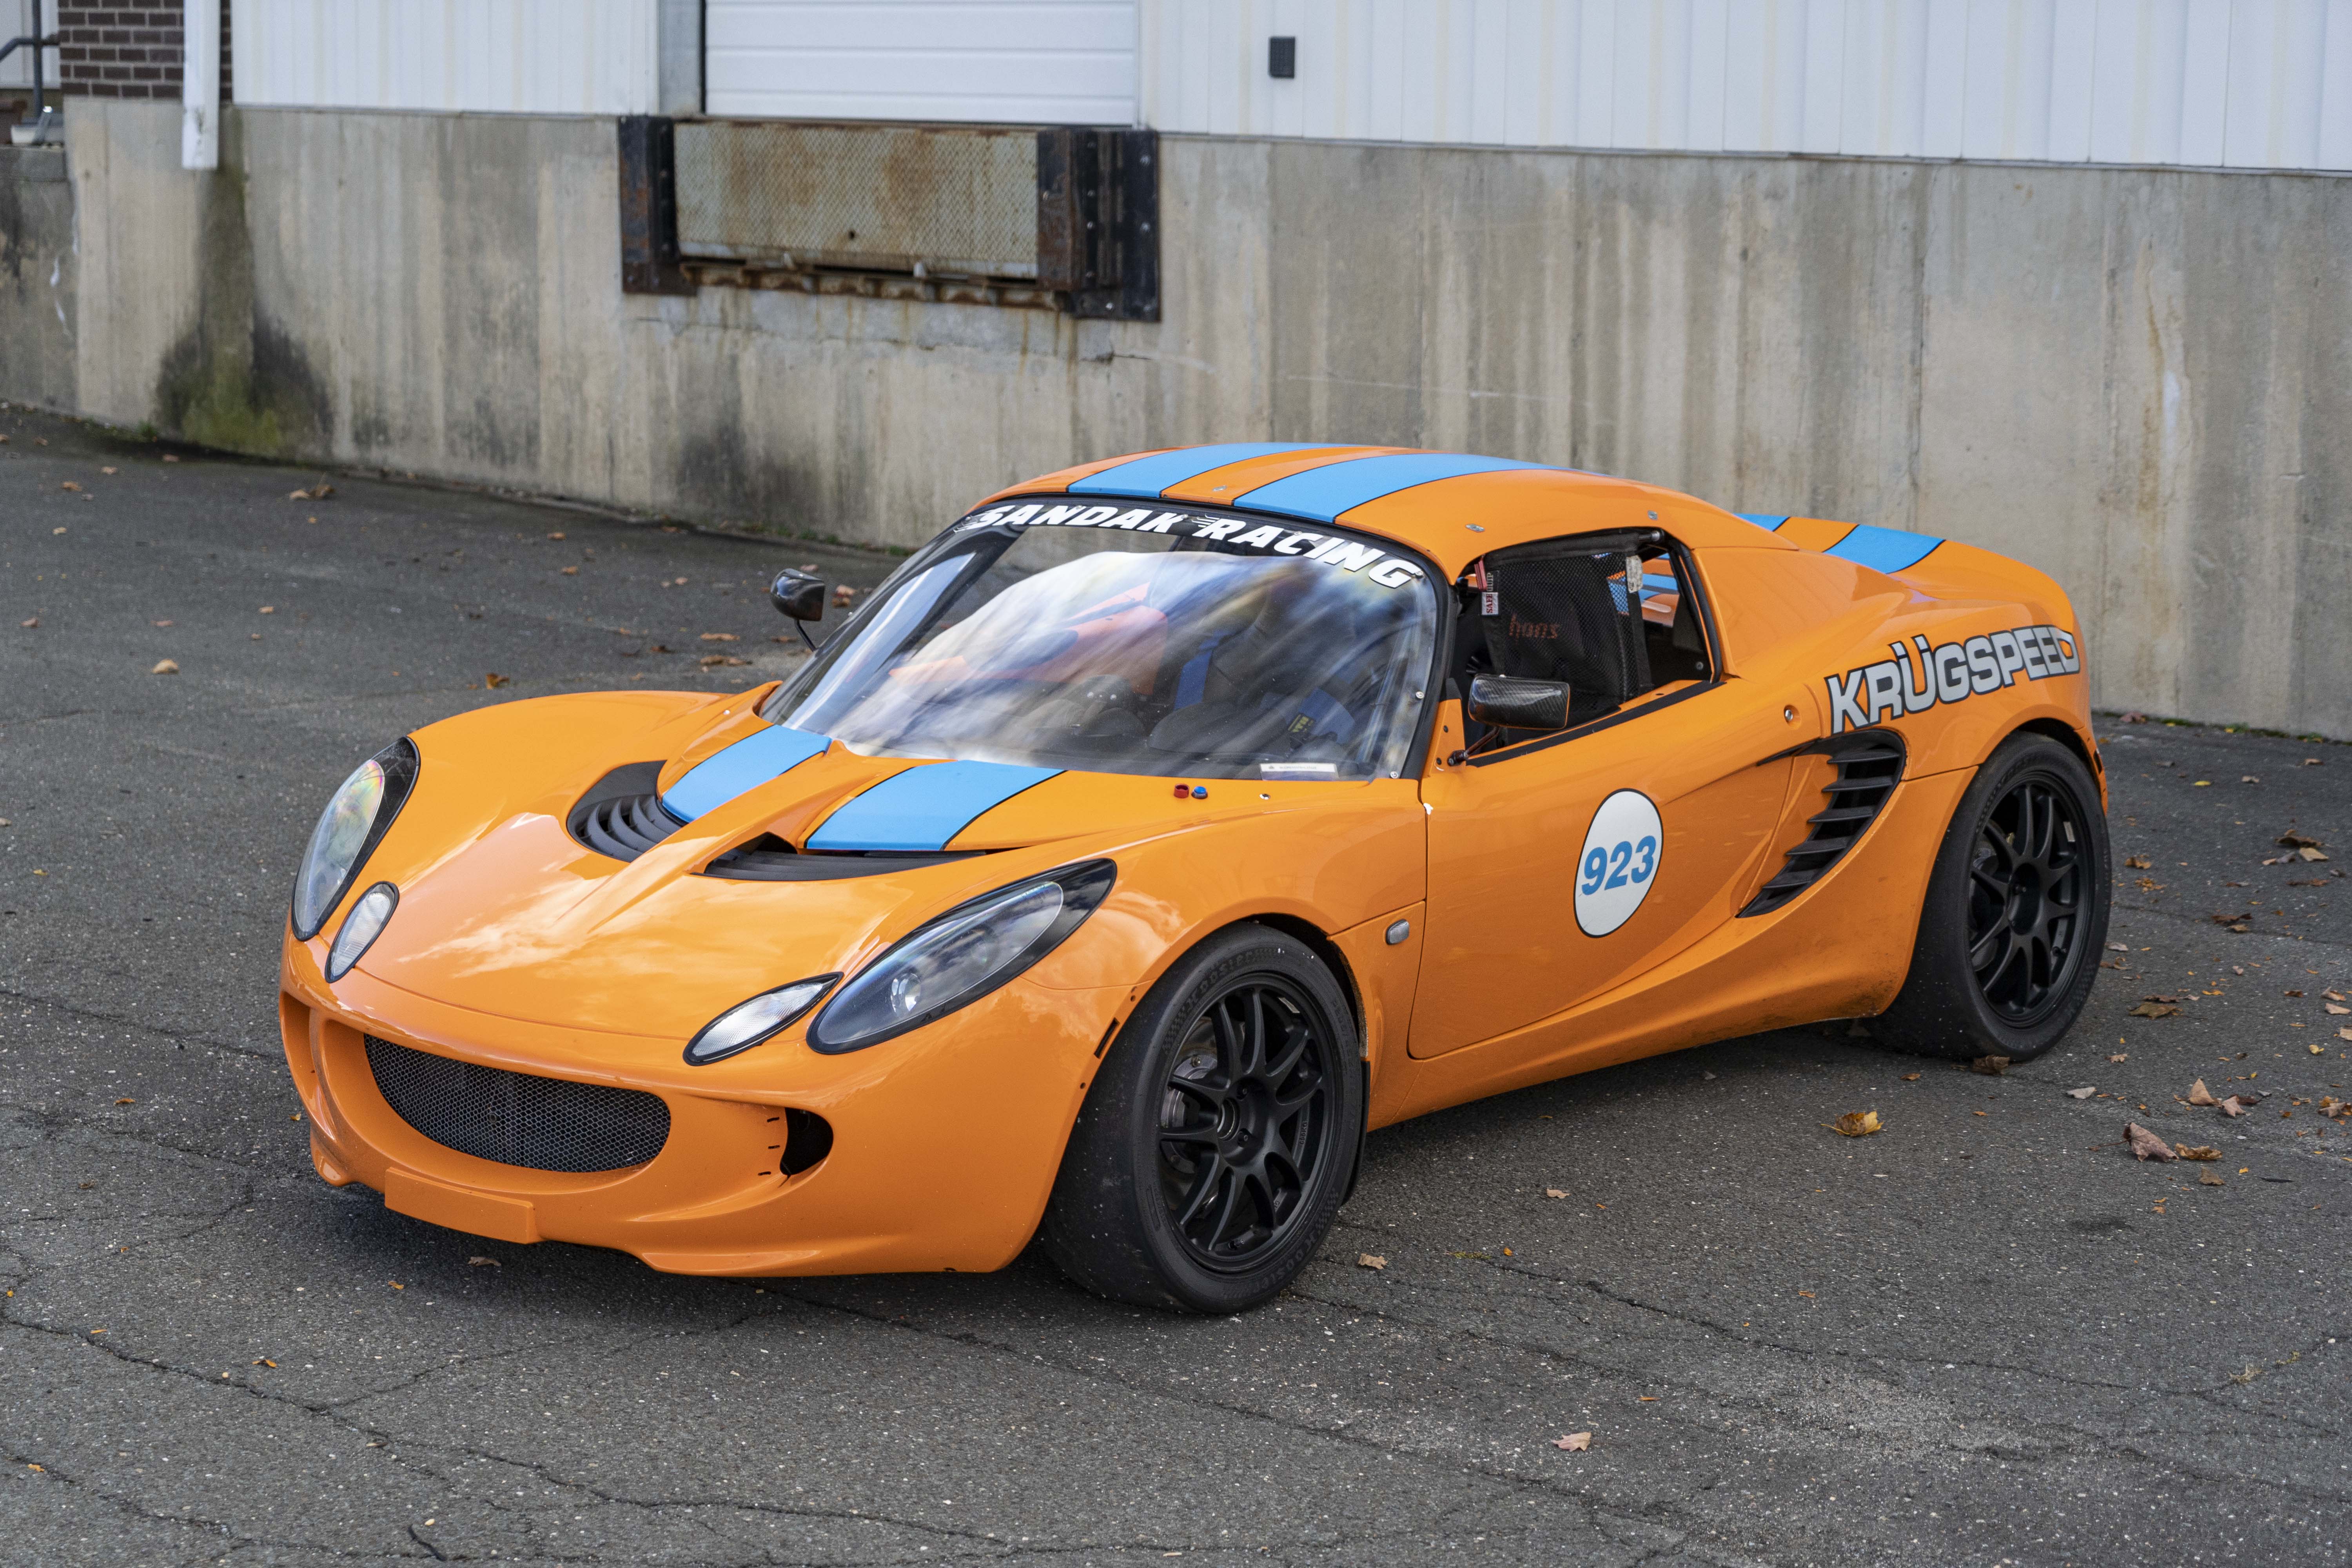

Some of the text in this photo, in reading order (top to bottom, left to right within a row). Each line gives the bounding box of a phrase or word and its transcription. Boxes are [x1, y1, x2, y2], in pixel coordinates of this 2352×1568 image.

[968, 504, 1422, 589] SANDAK RACING
[1824, 624, 2080, 735] KRÜGSPEED
[1581, 835, 1657, 896] 923
